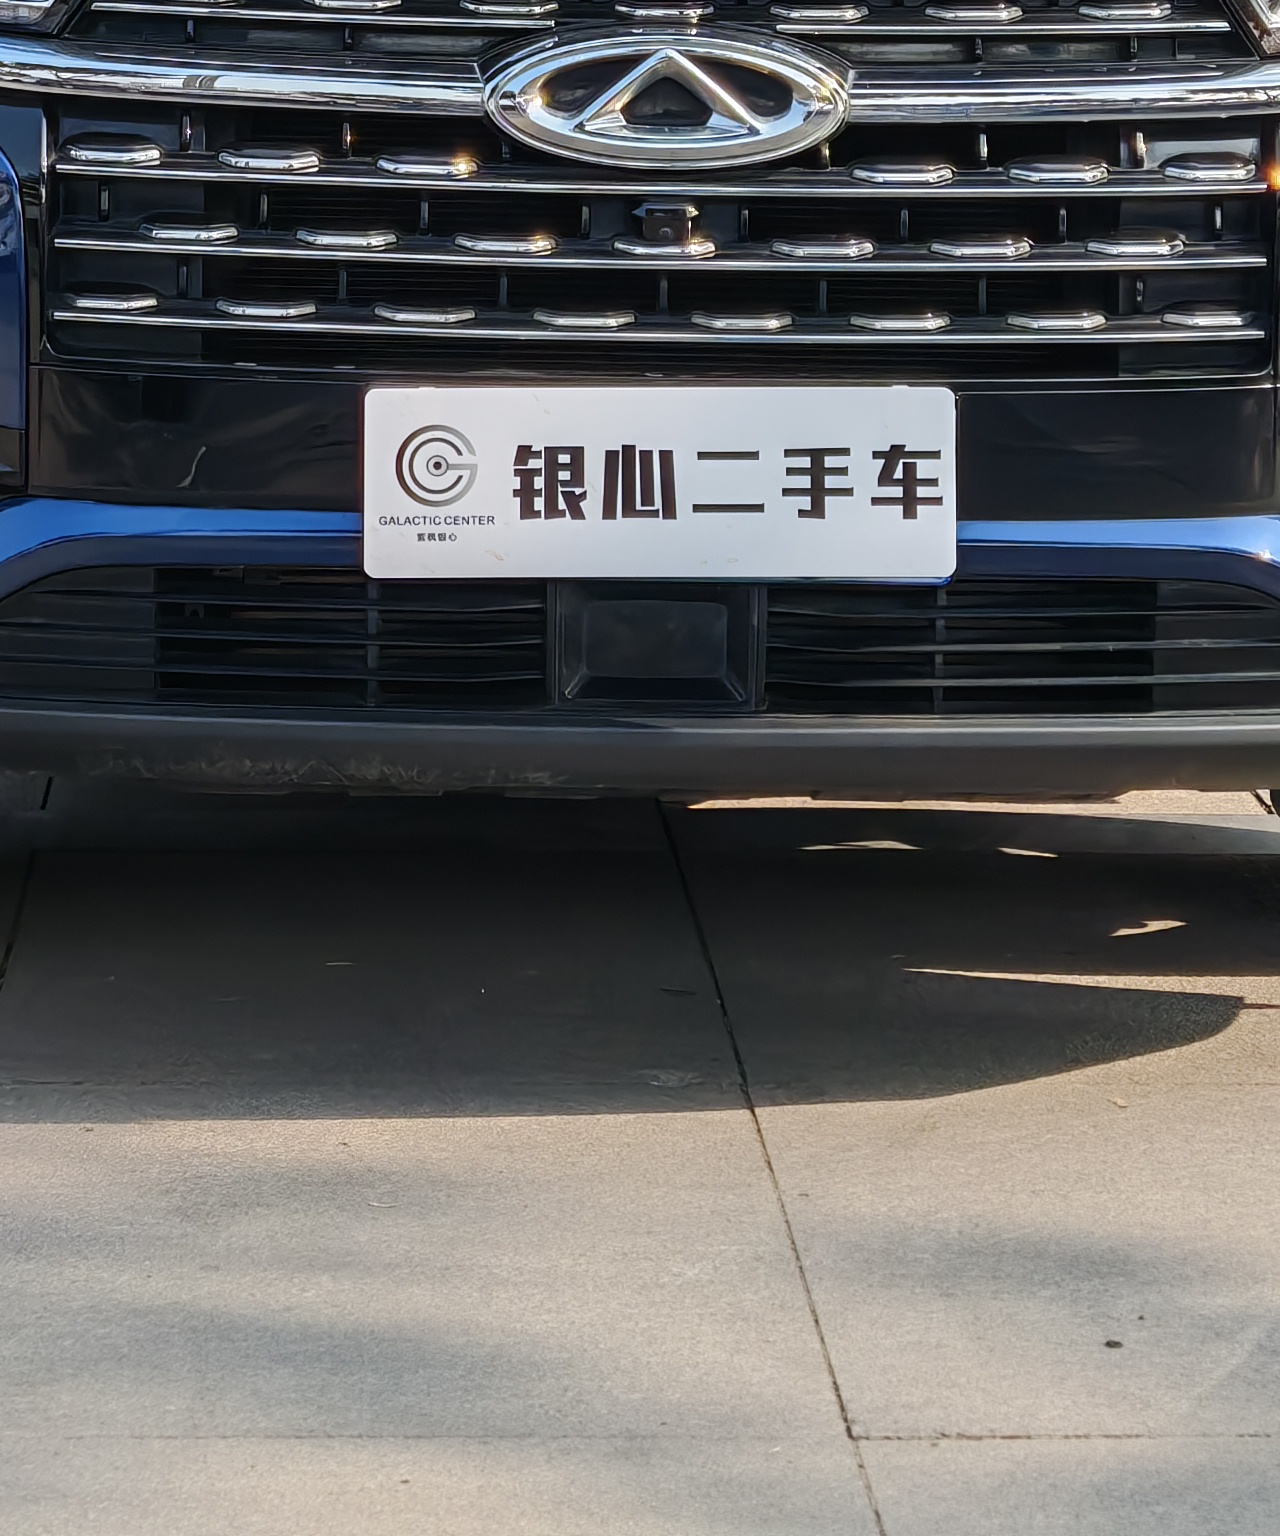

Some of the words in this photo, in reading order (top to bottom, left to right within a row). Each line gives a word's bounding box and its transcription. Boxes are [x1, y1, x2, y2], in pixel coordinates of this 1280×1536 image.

[512, 443, 944, 520] 银心二手车
[378, 515, 442, 526] GALACTIC
[444, 515, 496, 526] CENTER
